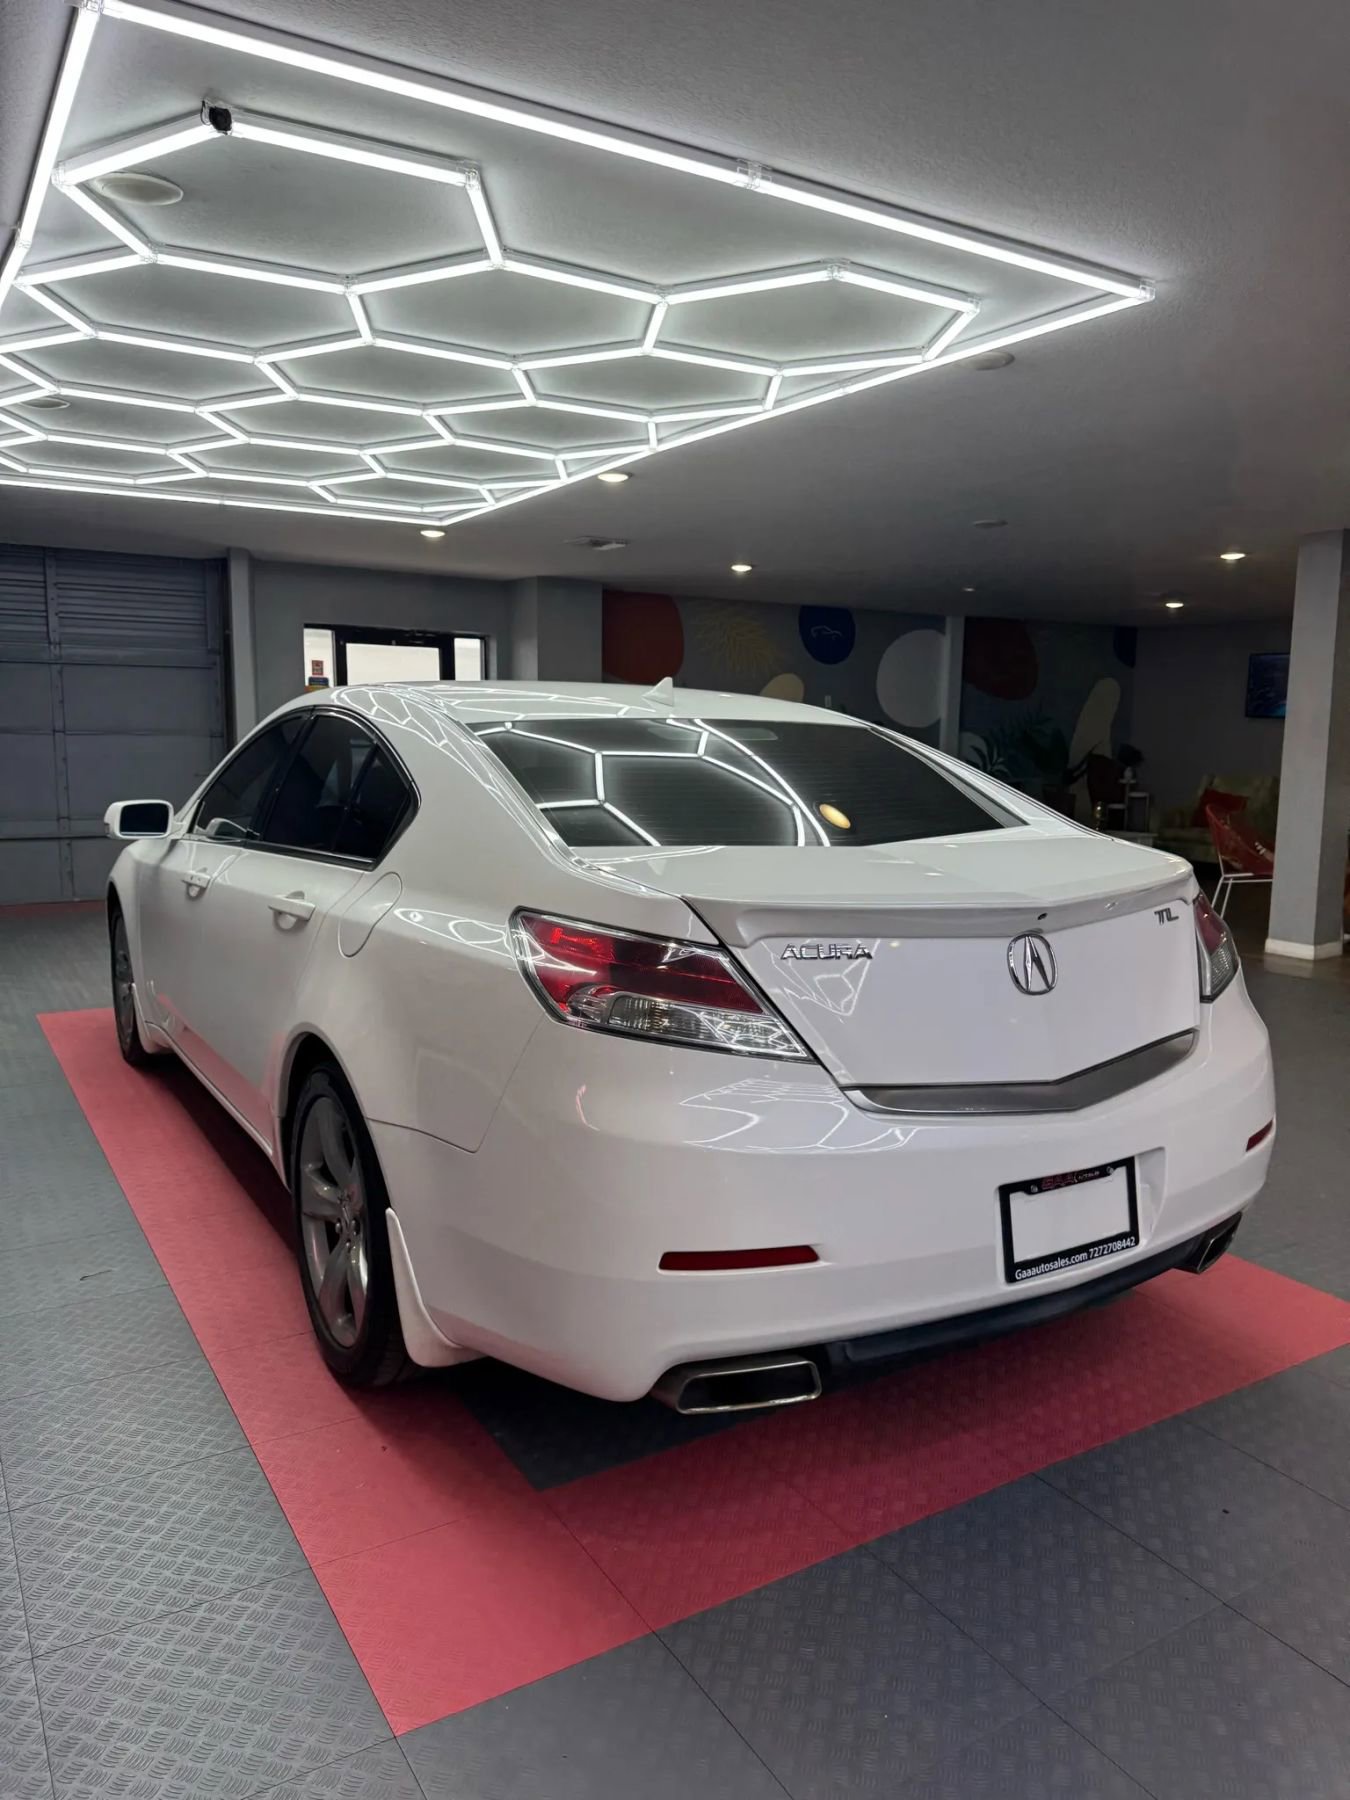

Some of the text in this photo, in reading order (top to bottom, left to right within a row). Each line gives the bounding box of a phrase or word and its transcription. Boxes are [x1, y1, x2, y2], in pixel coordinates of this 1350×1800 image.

[1153, 908, 1179, 926] TL
[780, 943, 873, 961] ACURA
[1015, 1236, 1136, 1280] Gaaautosales.com 7272708442
